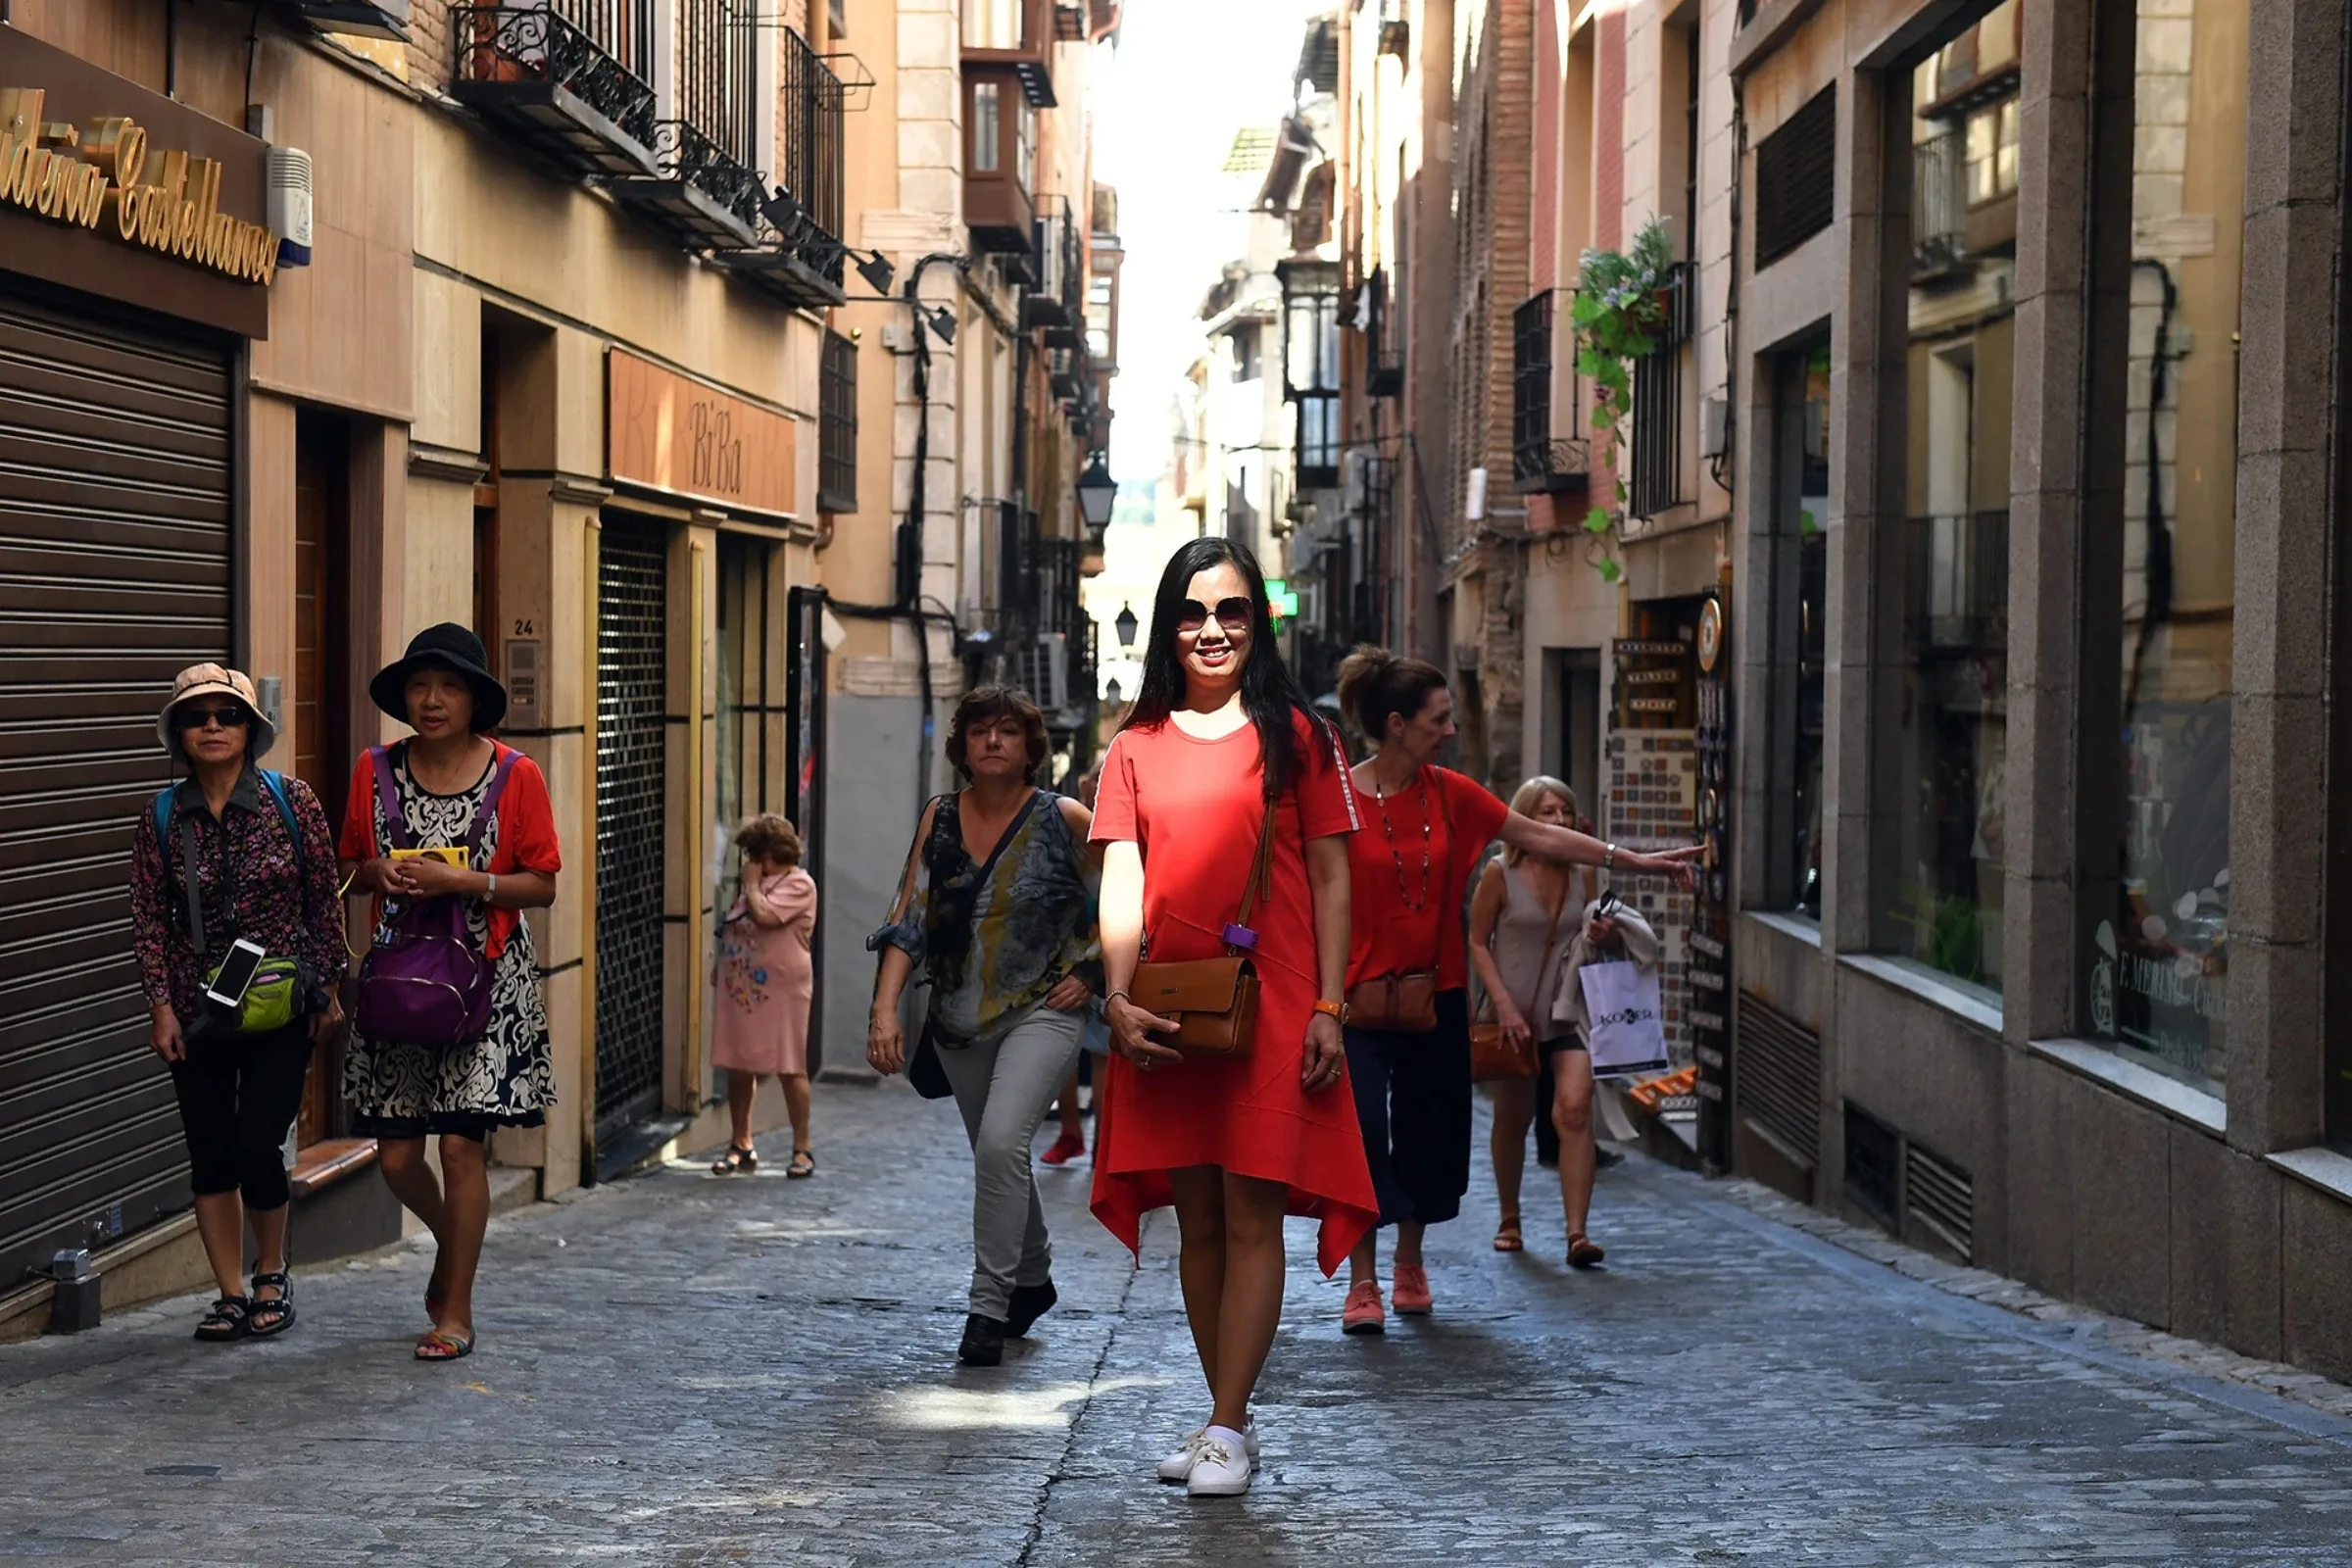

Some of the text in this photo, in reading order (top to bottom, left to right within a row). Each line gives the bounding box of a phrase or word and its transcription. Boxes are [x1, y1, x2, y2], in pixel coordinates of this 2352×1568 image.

[115, 117, 281, 286] Castellanos
[689, 400, 742, 495] BiBa
[514, 619, 533, 636] 24
